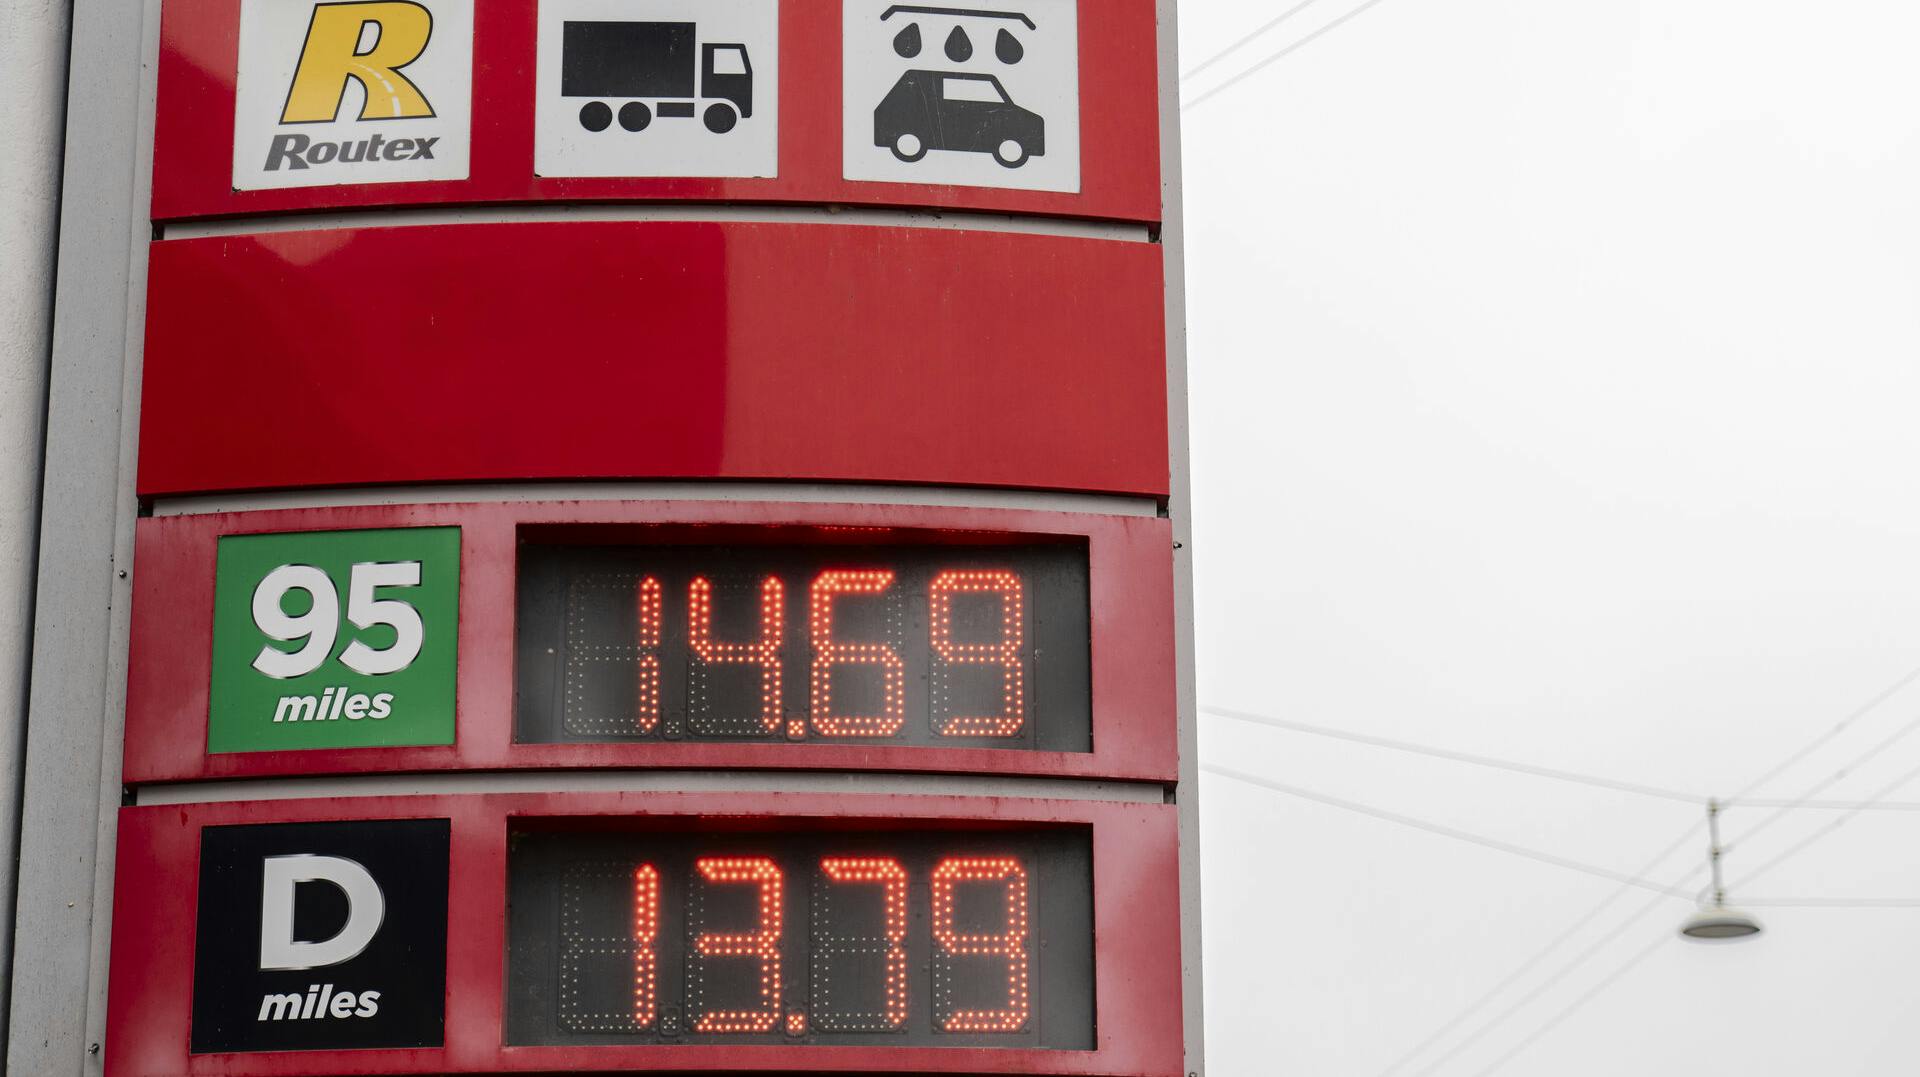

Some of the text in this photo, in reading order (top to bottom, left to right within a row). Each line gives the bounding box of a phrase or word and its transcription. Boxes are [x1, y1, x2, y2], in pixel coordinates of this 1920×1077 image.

[279, 0, 437, 125] R
[263, 133, 440, 171] Routex
[251, 560, 425, 679] 95
[639, 570, 1023, 736] 14.69
[273, 687, 394, 722] miles
[259, 853, 386, 971] D
[635, 858, 1028, 1032] 13.79
[258, 984, 381, 1021] miles
